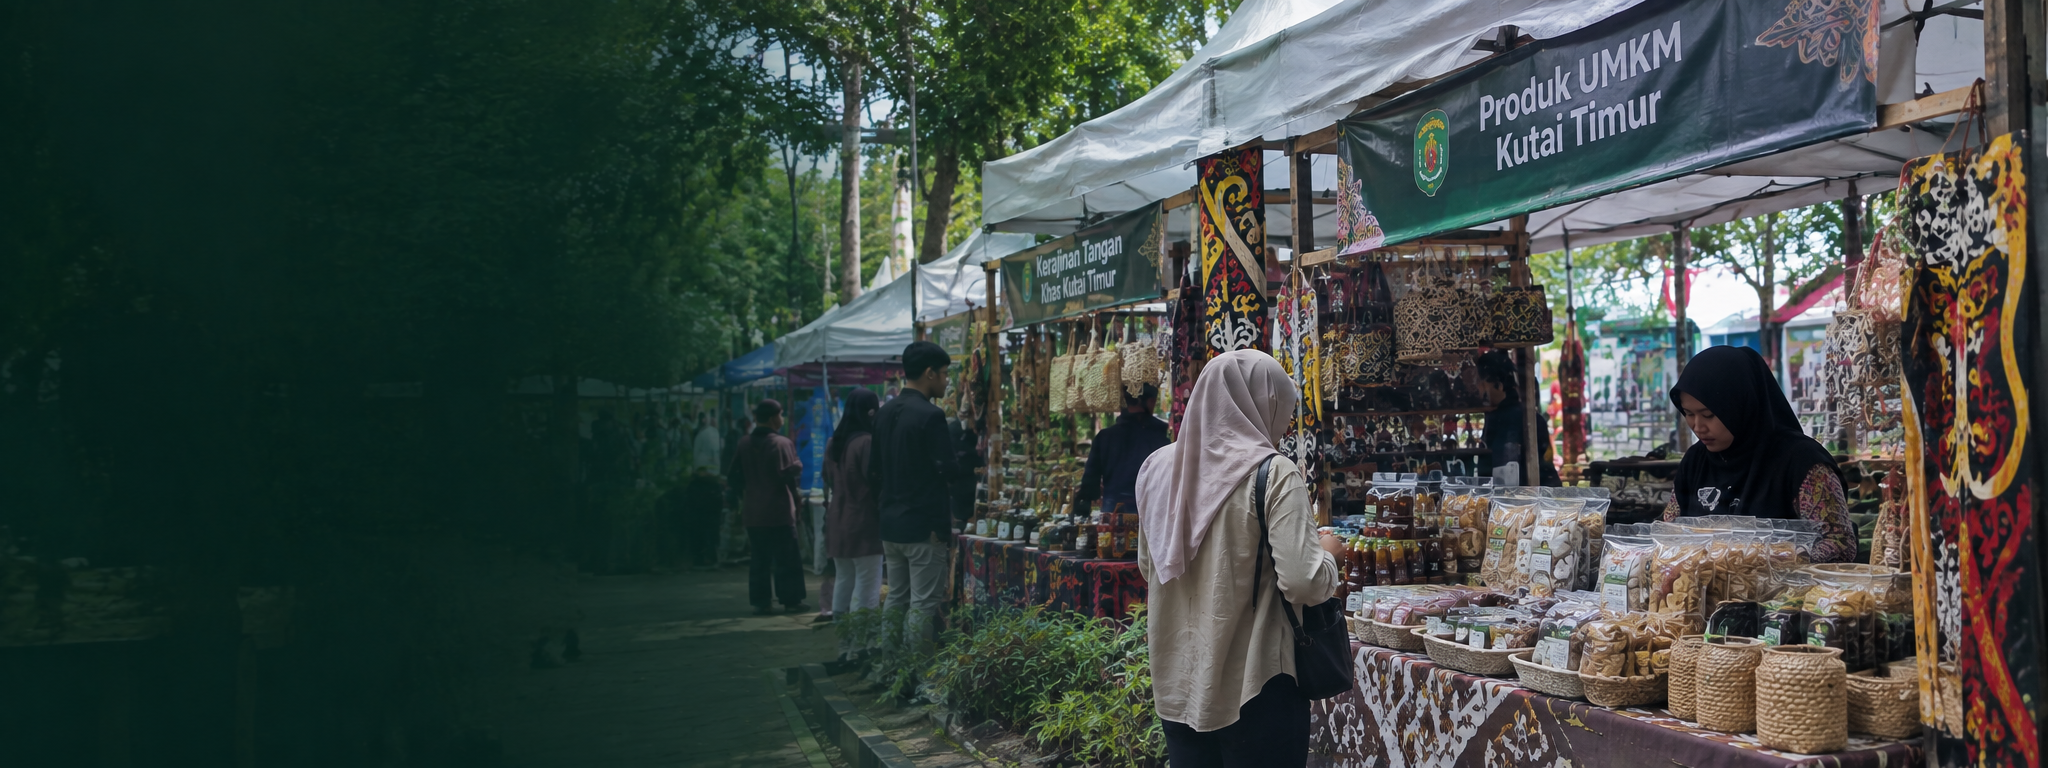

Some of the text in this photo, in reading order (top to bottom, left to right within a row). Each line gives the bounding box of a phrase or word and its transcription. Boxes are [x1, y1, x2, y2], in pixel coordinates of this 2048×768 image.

[1479, 20, 1682, 132] Produk UMKM
[1496, 89, 1662, 171] Kutai Timur
[1036, 235, 1123, 278] Kerajinan Tangan
[1041, 268, 1117, 304] Khas Kutai Timur
